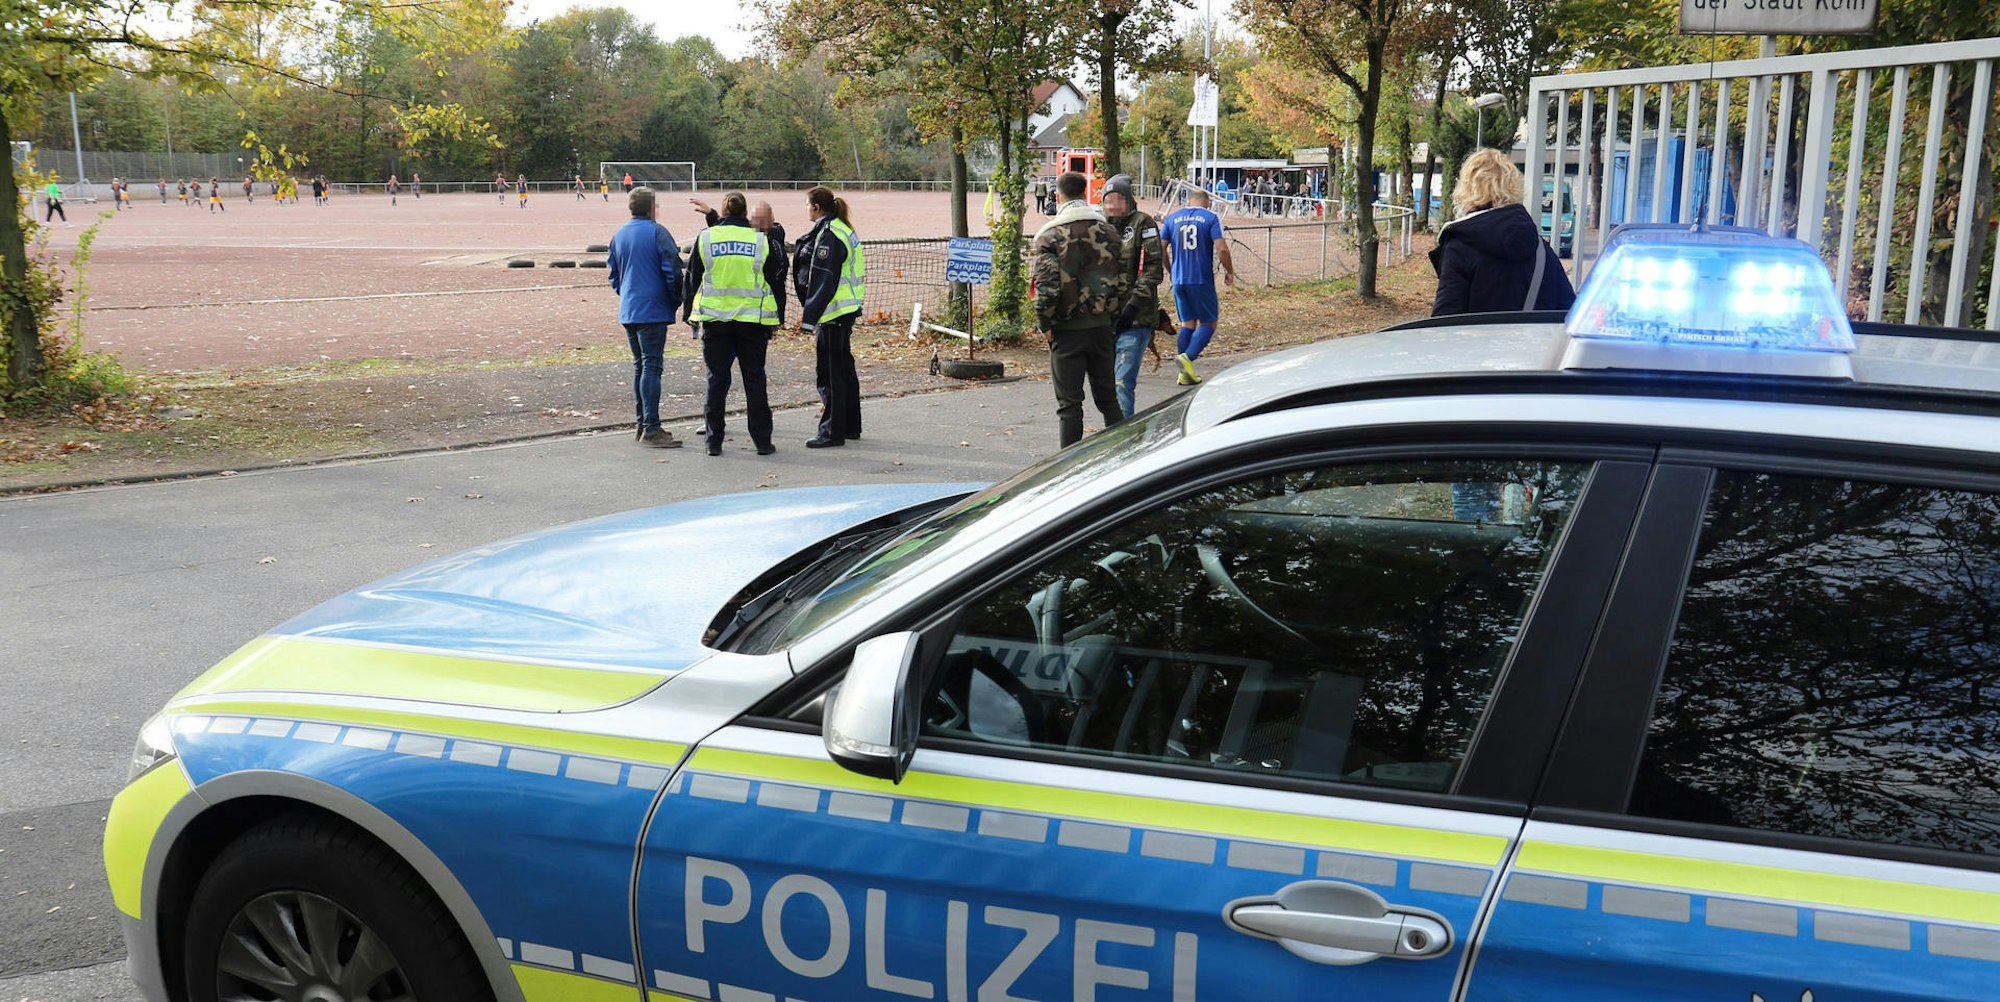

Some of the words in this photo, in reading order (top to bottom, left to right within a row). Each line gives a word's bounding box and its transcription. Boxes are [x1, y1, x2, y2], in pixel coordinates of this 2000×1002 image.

[1180, 224, 1198, 250] 13
[711, 242, 756, 256] POLIZEI
[949, 239, 993, 251] Parkplatz
[948, 260, 991, 272] Parkplatz
[684, 856, 1198, 1002] POLIZEI
